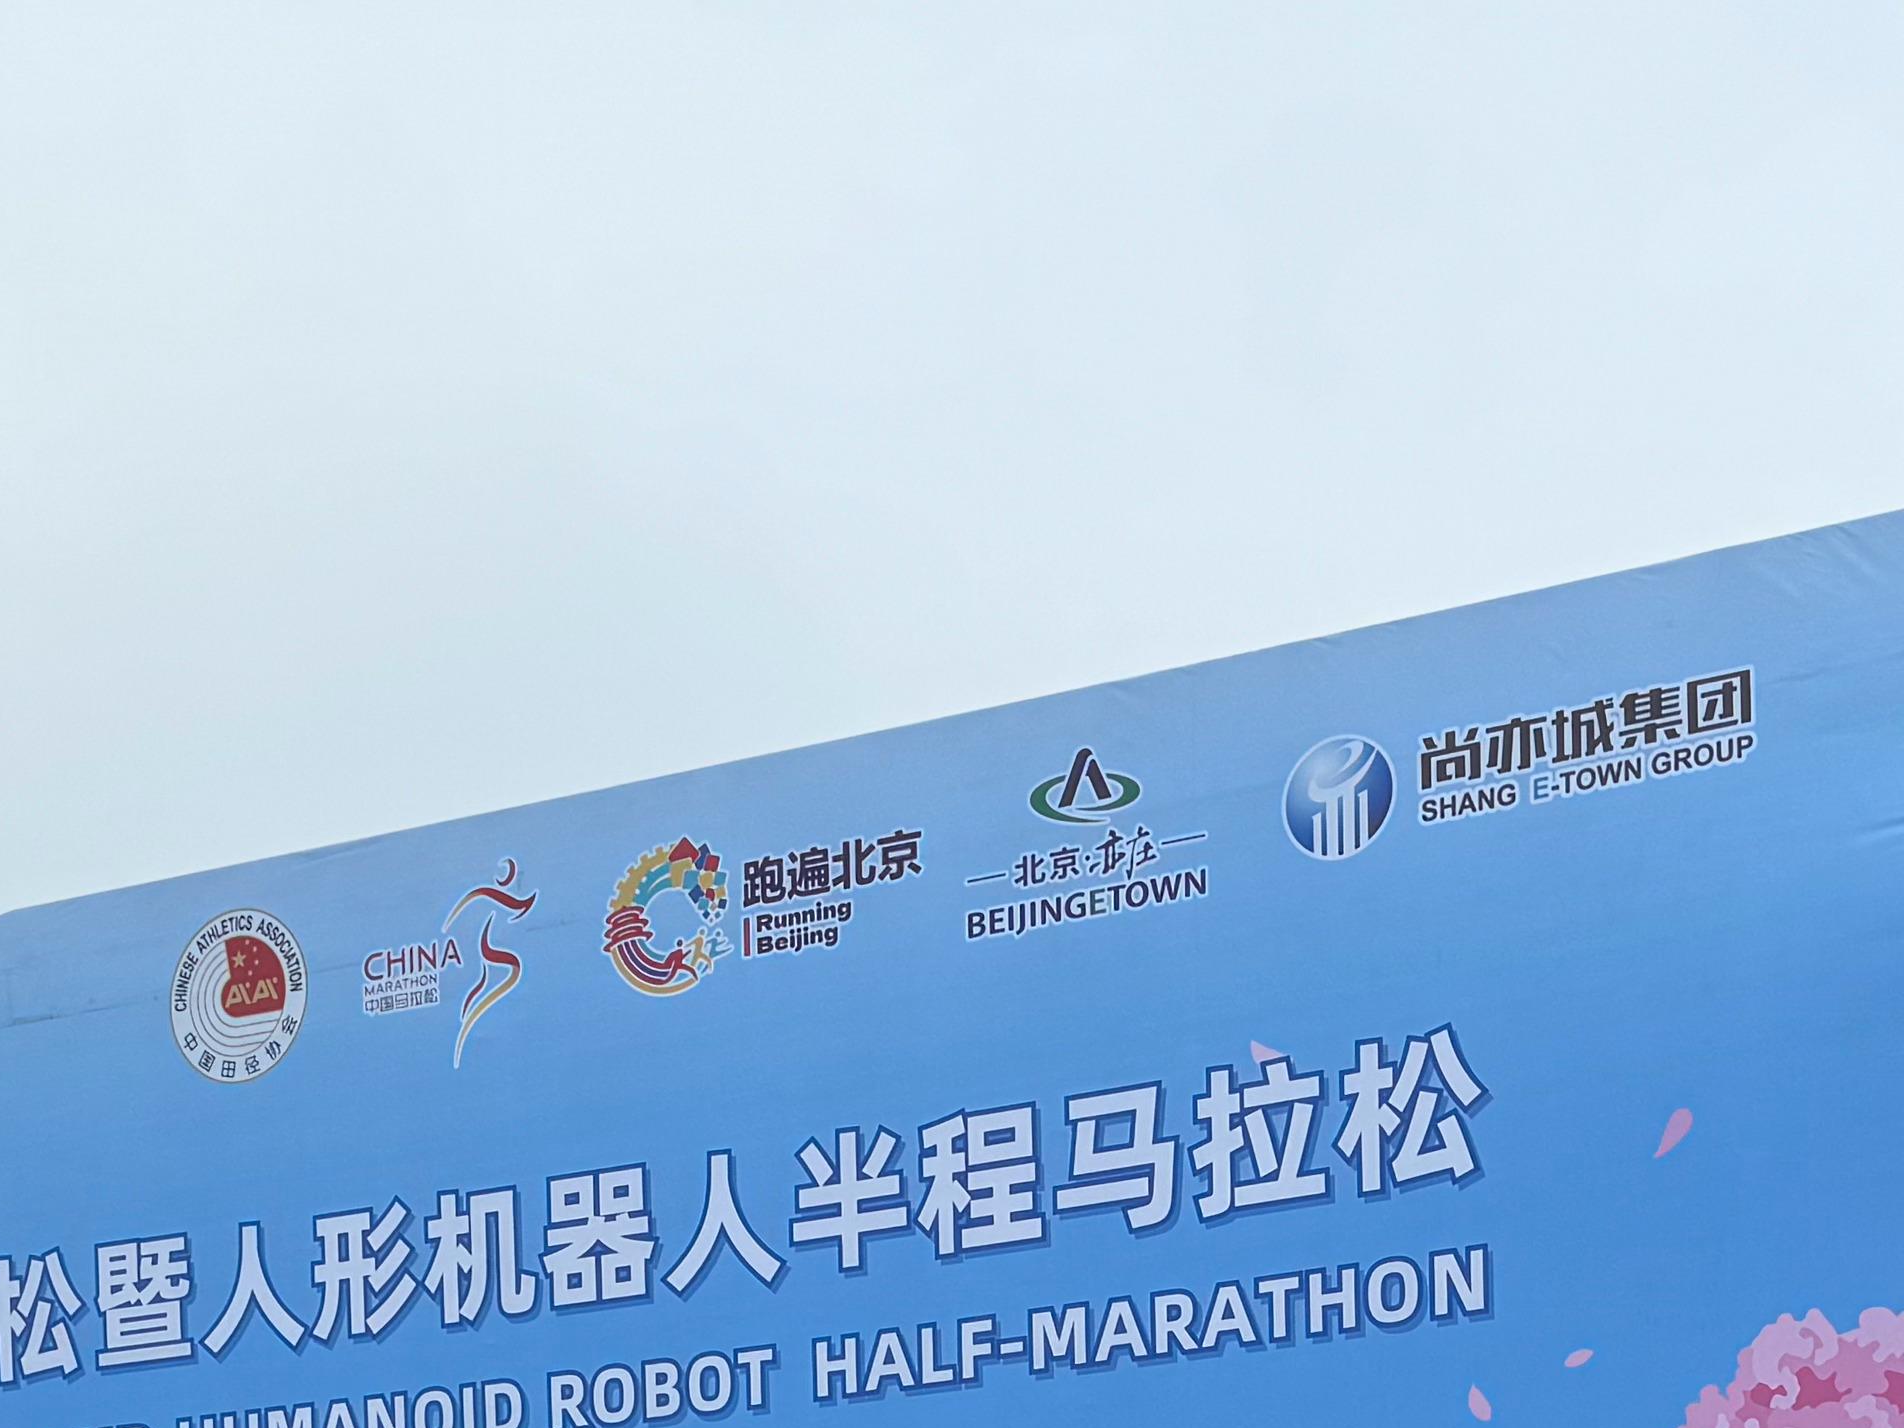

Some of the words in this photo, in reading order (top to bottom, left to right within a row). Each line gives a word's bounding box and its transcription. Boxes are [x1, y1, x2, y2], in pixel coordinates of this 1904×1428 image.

[1420, 669, 1751, 790] 尚亦城集团
[1422, 784, 1517, 823] SHANG
[1533, 758, 1641, 799] E-TOWN
[1651, 735, 1754, 774] GROUP
[743, 829, 922, 908] 跑遍北京
[756, 901, 852, 933] Running
[967, 870, 1207, 939] BEIJINGETOWN
[175, 951, 198, 1012] CHINESE
[196, 914, 253, 954] ATHLETICS
[257, 918, 303, 992] ASSOCIATION
[363, 938, 463, 982] CHINA
[756, 926, 840, 956] Beijing
[364, 973, 439, 997] MARATHON
[183, 1015, 298, 1079] 中国田径协会
[814, 1244, 1490, 1402] HALF-MARATHON
